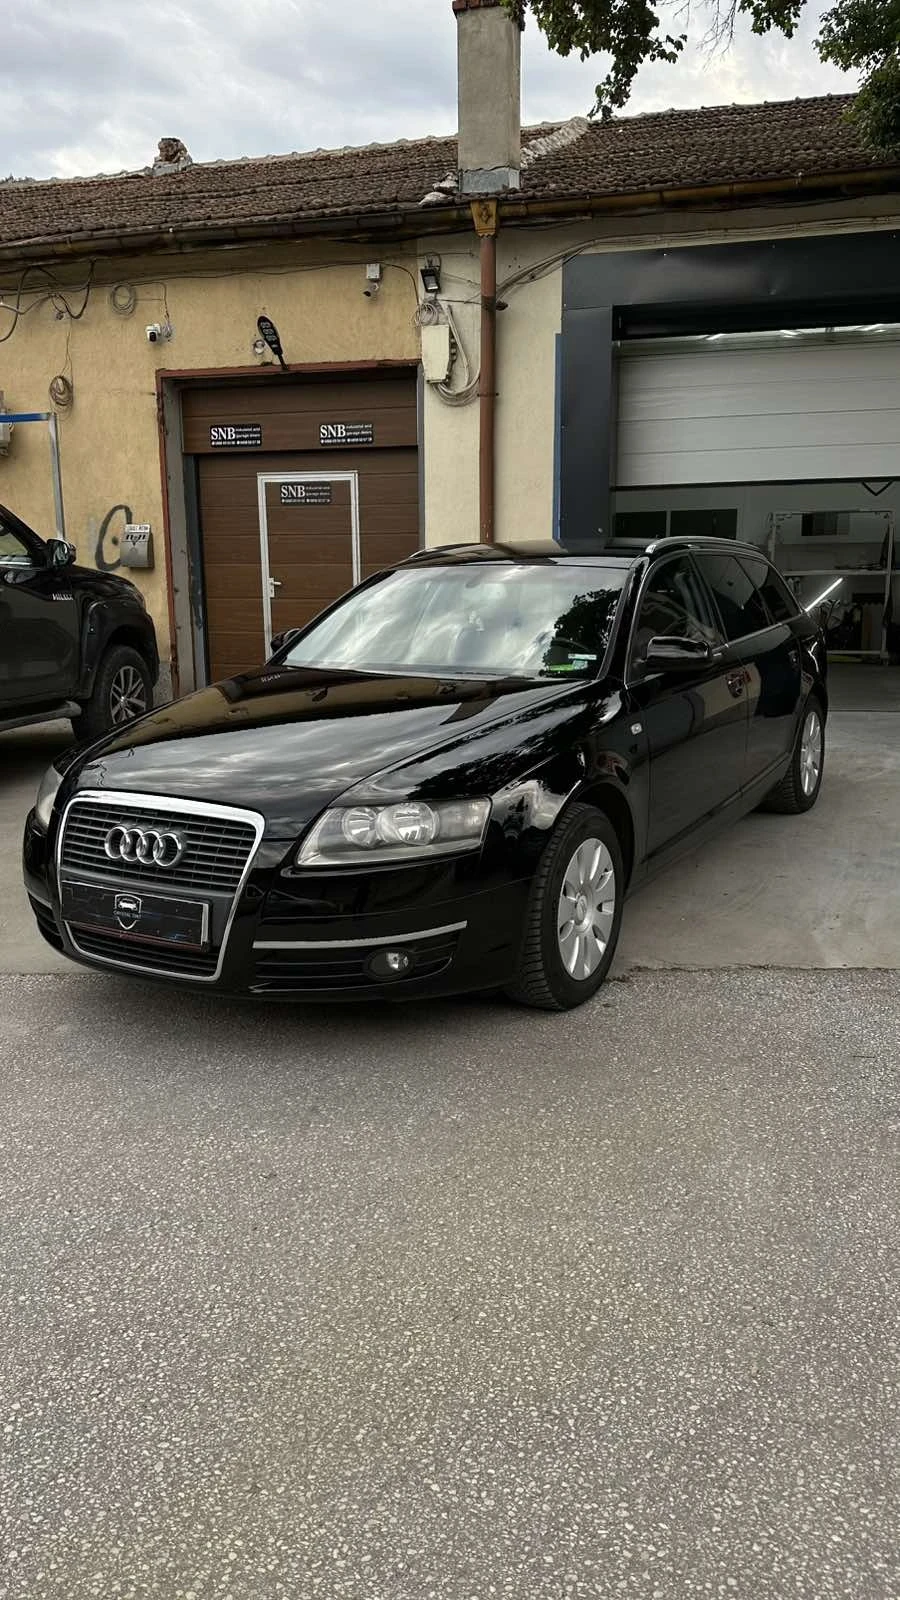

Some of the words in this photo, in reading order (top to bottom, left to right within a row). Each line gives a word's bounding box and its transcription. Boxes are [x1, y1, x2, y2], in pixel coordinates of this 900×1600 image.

[211, 427, 236, 440] SNB
[320, 424, 346, 438] SNB
[281, 485, 306, 498] SNB
